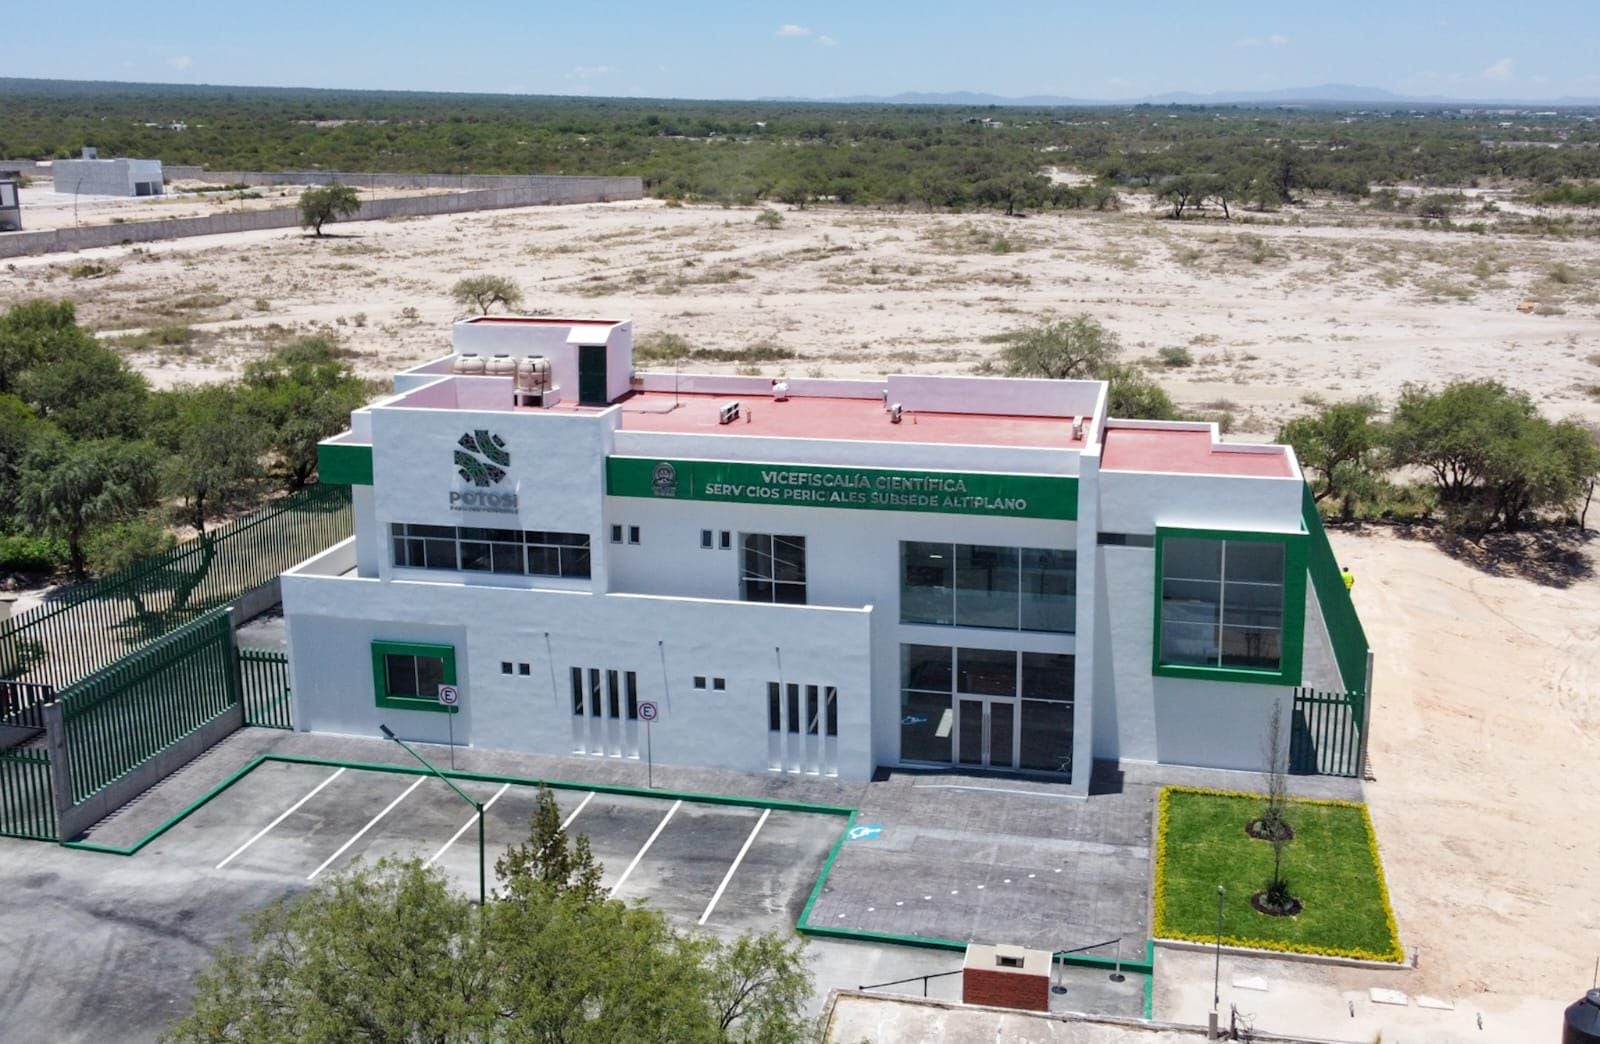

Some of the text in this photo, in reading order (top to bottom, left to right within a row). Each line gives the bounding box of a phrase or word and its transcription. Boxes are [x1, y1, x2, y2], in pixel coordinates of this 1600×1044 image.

[761, 471, 967, 492] VICEFISCALÍA CIENTÍFICA
[870, 491, 939, 506] SUBSEDE
[943, 496, 1027, 511] ALTIPLANO
[445, 690, 453, 701] E
[643, 706, 652, 717] E
